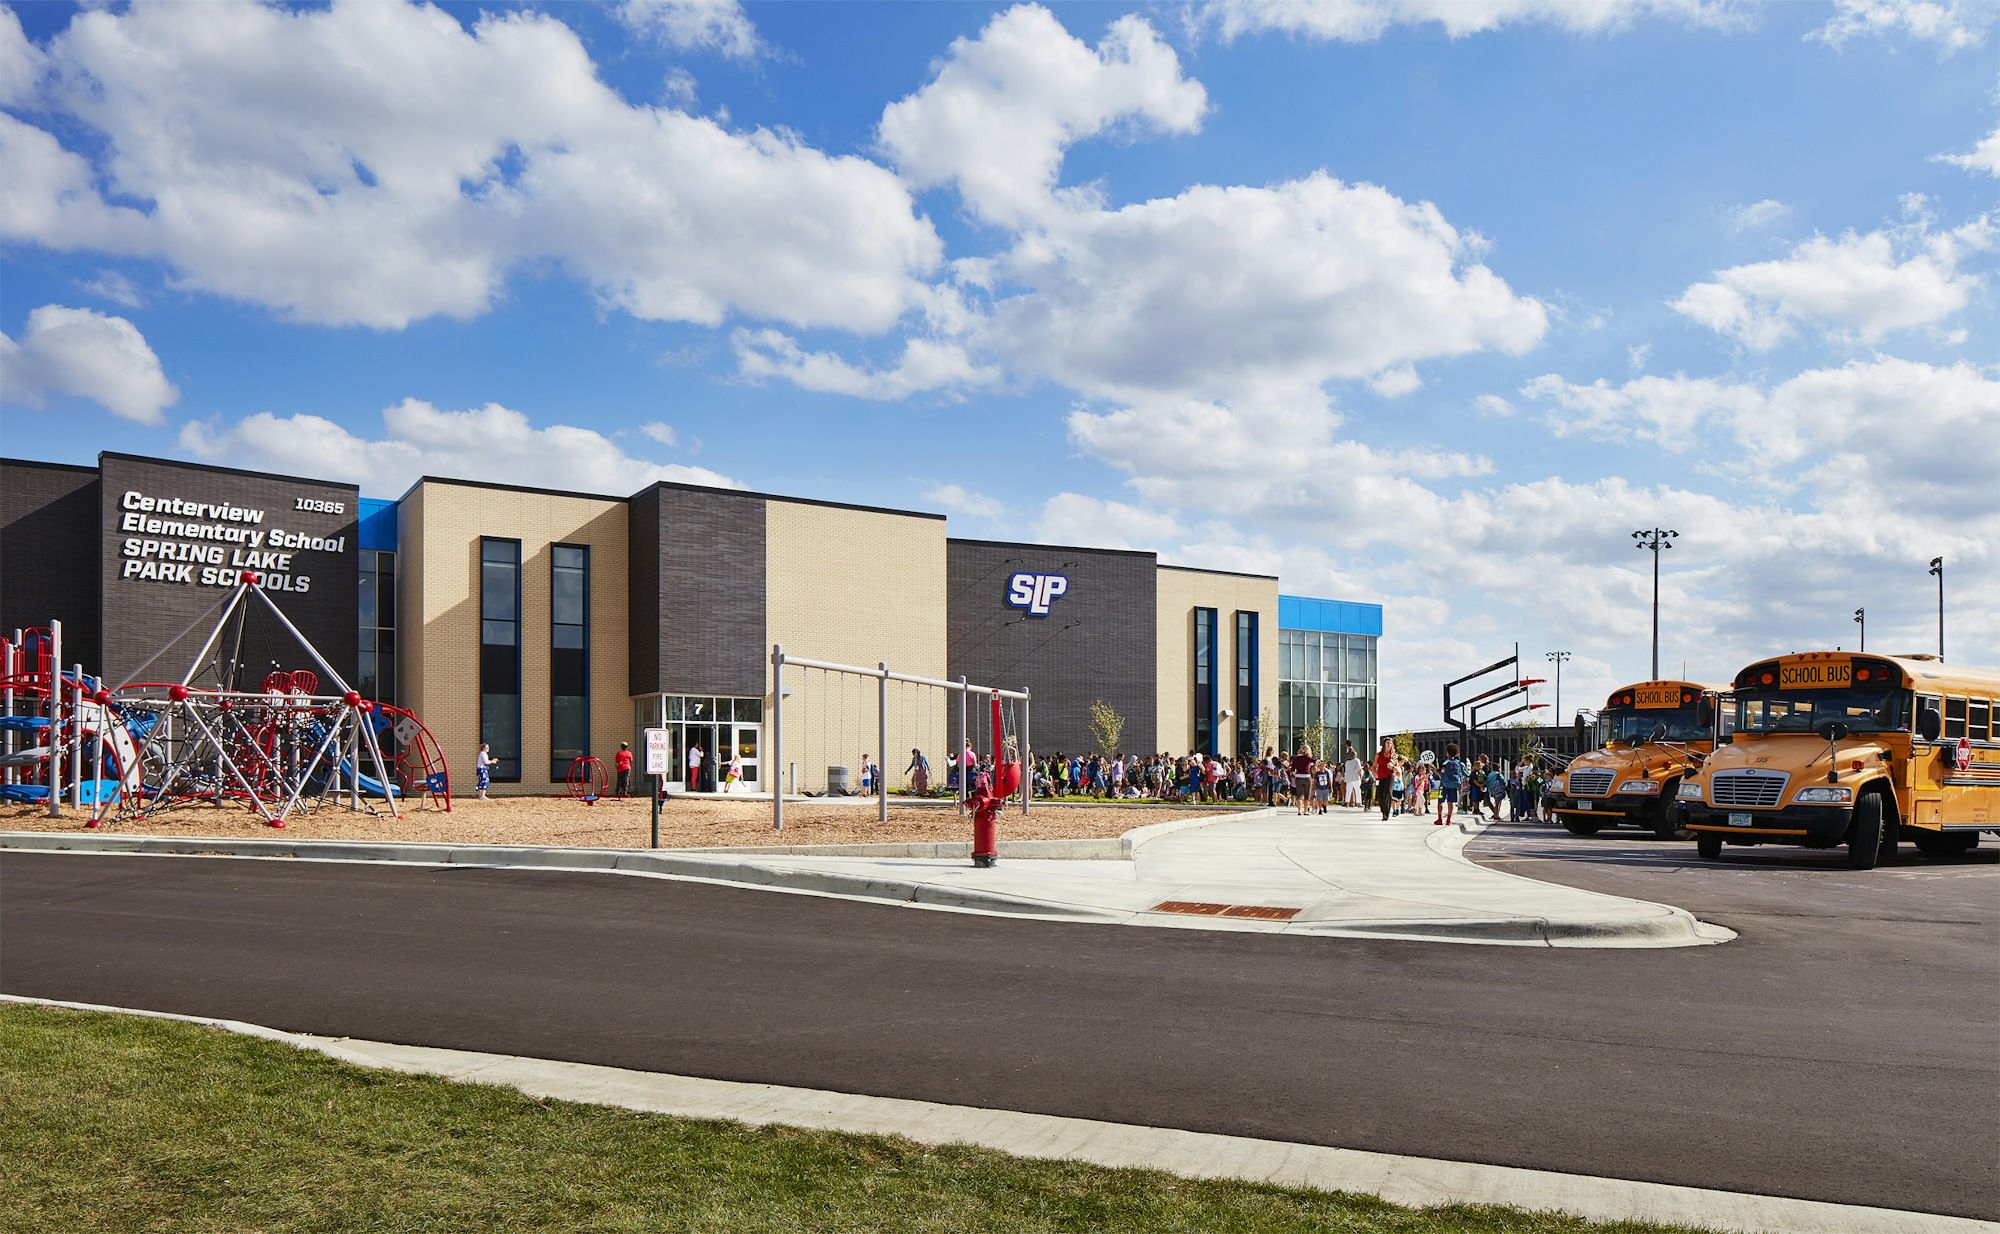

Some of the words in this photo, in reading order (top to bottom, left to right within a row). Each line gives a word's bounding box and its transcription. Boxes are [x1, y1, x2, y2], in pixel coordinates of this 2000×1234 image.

[121, 490, 265, 524] Centerview
[294, 497, 345, 515] 10365
[121, 512, 265, 548] Elementary
[267, 528, 345, 553] School
[122, 537, 225, 565] SPRING
[231, 549, 293, 571] LAKE
[122, 559, 195, 583] PARK
[1009, 573, 1068, 614] SLP
[1781, 666, 1825, 684] SCHOOL
[1827, 664, 1851, 682] BUS
[1636, 691, 1663, 704] SCHOOL
[1664, 690, 1679, 703] BUS
[694, 703, 704, 715] 7
[653, 732, 663, 741] NO
[649, 742, 667, 750] PARKING
[1958, 747, 1970, 761] STOP
[1421, 752, 1434, 762] 135
